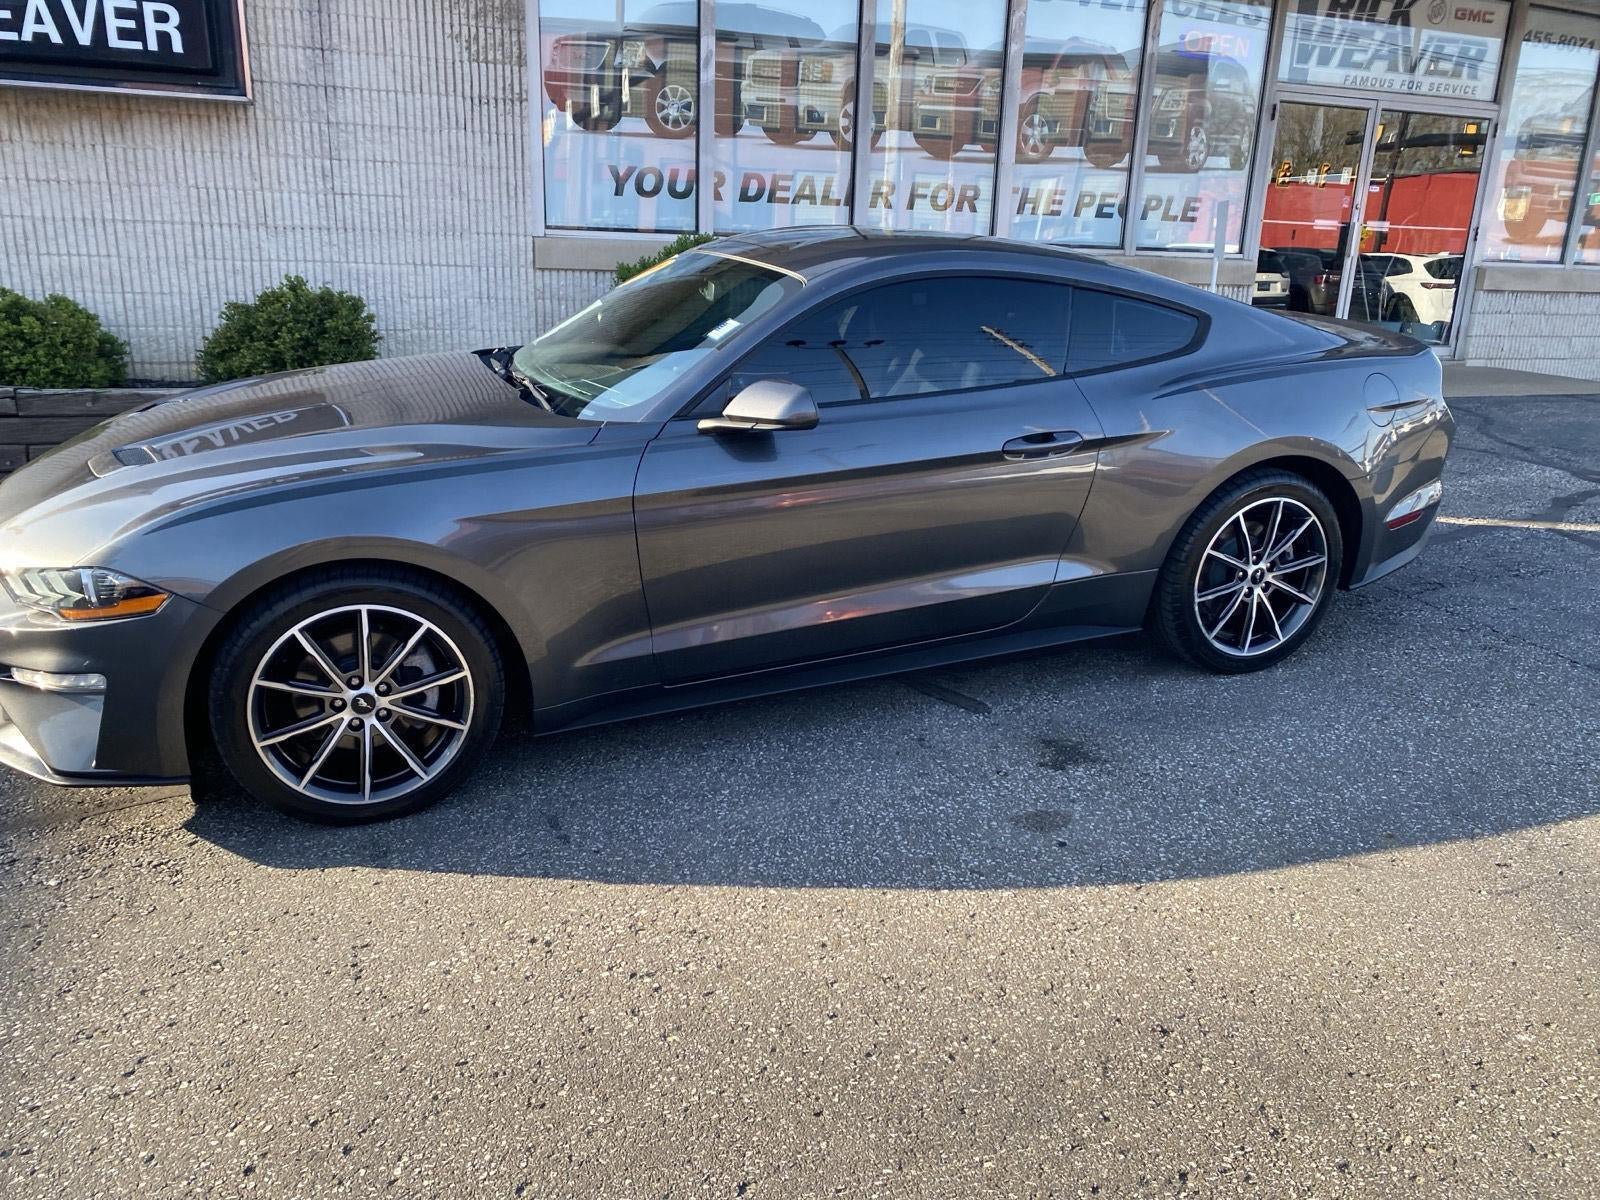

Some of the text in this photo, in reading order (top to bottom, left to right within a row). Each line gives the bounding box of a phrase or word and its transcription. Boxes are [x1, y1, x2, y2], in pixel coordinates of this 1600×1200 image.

[1454, 7, 1495, 24] GMC
[1183, 30, 1250, 58] OPEN
[1294, 22, 1489, 81] WEAVER
[1343, 74, 1479, 96] FAMOUS FOR SERVICE
[738, 171, 896, 209] DEALR
[905, 182, 982, 213] FOR
[1073, 190, 1202, 223] PEPLE
